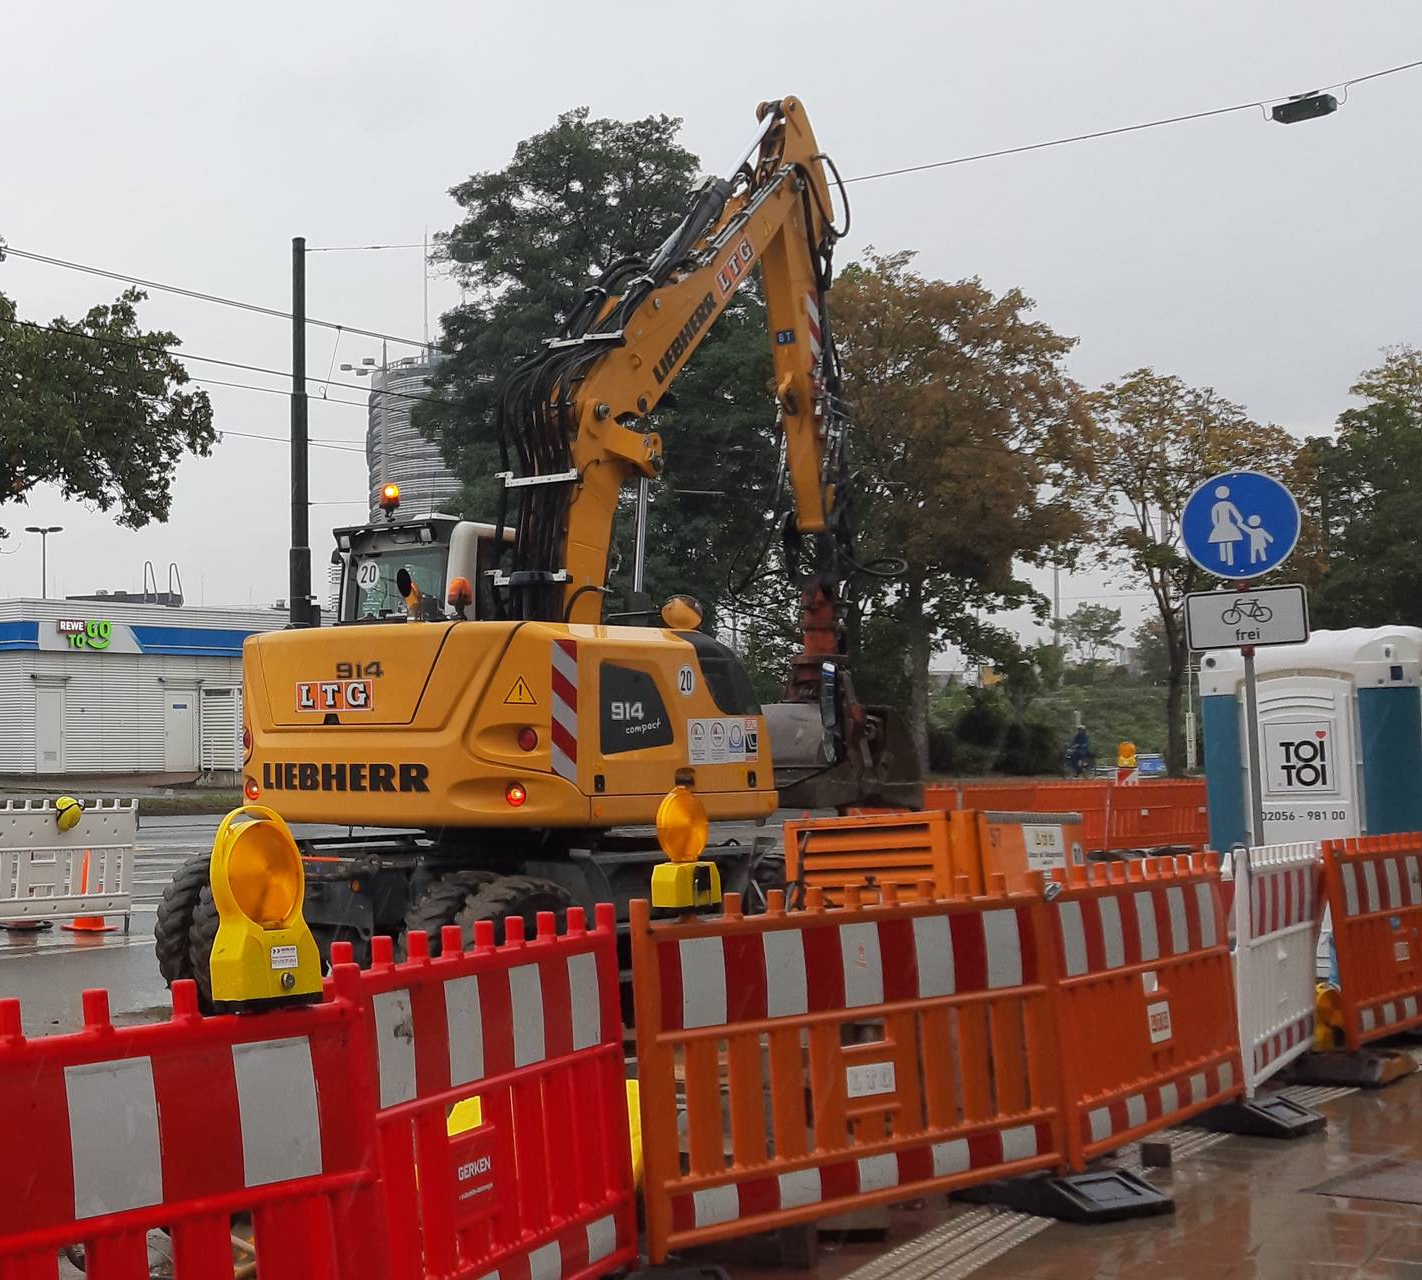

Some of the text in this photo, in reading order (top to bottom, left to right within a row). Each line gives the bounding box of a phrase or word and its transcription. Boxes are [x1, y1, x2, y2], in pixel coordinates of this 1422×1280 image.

[716, 239, 753, 292] LTG
[652, 291, 717, 384] LIEBHERR
[360, 565, 377, 584] 20
[60, 620, 84, 631] REWE
[86, 620, 112, 639] GO
[1236, 628, 1260, 641] frei
[67, 633, 86, 648] TO
[336, 661, 385, 679] 914
[680, 670, 692, 691] 20
[300, 682, 369, 708] LTG
[611, 702, 644, 720] 914
[625, 717, 661, 735] compact
[1279, 740, 1326, 763] TOI
[263, 762, 430, 793] LIEBHERR
[1280, 764, 1327, 786] TOI
[1261, 811, 1295, 821] 02056
[1307, 810, 1327, 820] 981
[1332, 810, 1346, 821] 00
[458, 1155, 491, 1181] GERKEN
